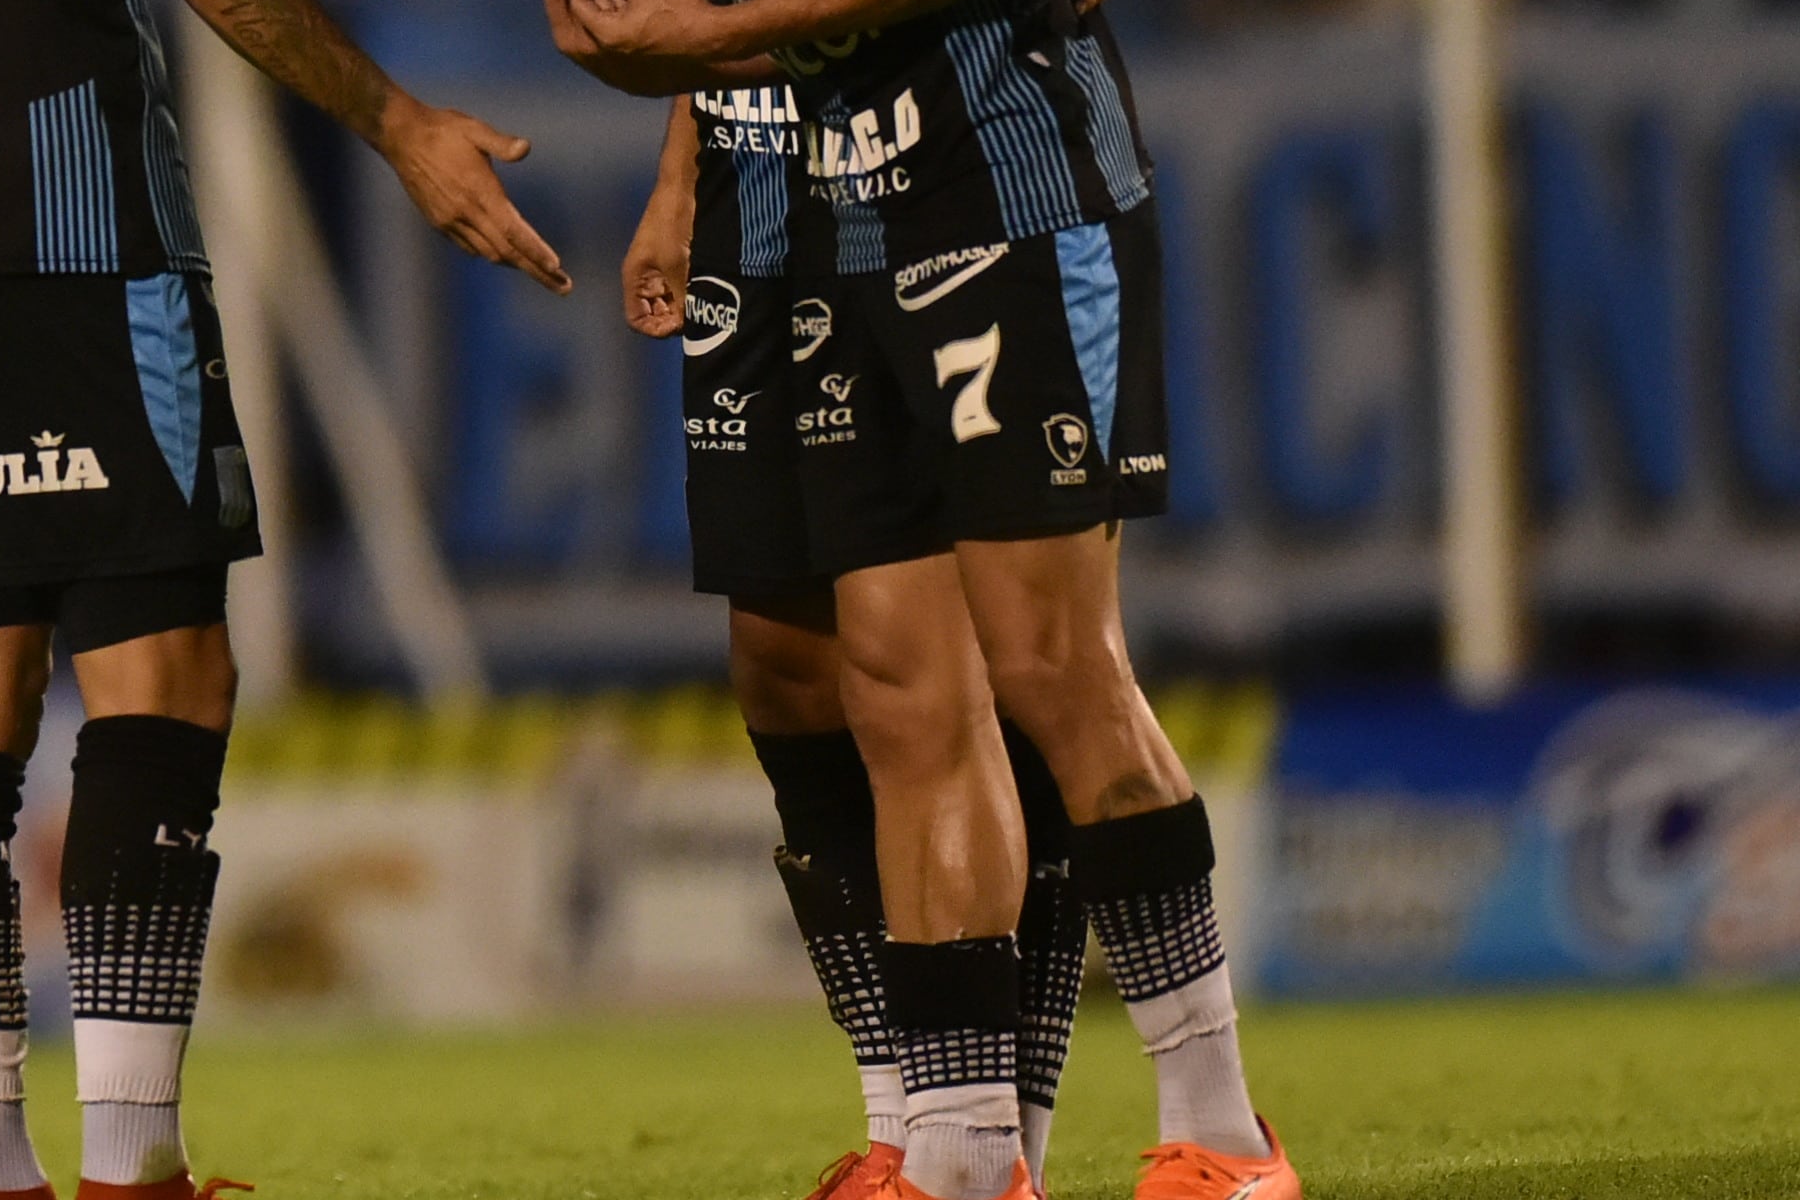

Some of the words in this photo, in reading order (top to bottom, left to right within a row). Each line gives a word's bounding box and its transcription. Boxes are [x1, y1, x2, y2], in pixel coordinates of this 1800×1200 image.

[933, 322, 1002, 445] 7
[685, 416, 748, 436] sta
[795, 406, 854, 432] sta
[690, 439, 748, 452] VIAJES
[801, 429, 857, 448] VIAJES
[1119, 453, 1167, 475] LYON
